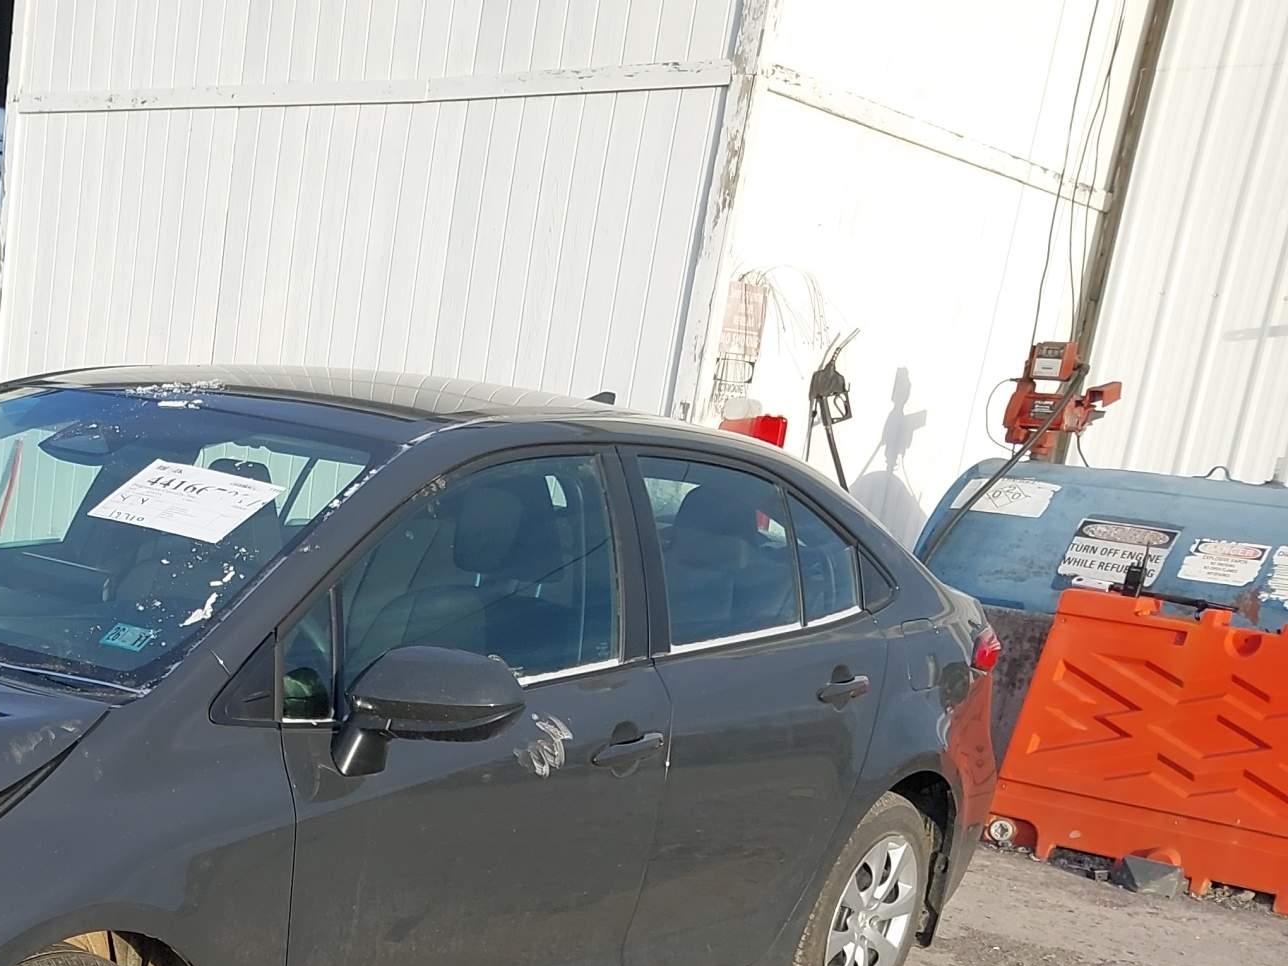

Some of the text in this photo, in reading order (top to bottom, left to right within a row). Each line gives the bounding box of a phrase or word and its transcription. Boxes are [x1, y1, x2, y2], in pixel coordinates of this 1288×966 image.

[1062, 556, 1097, 569] WHILE
[1071, 542, 1163, 565] TURN OFF ENGNE
